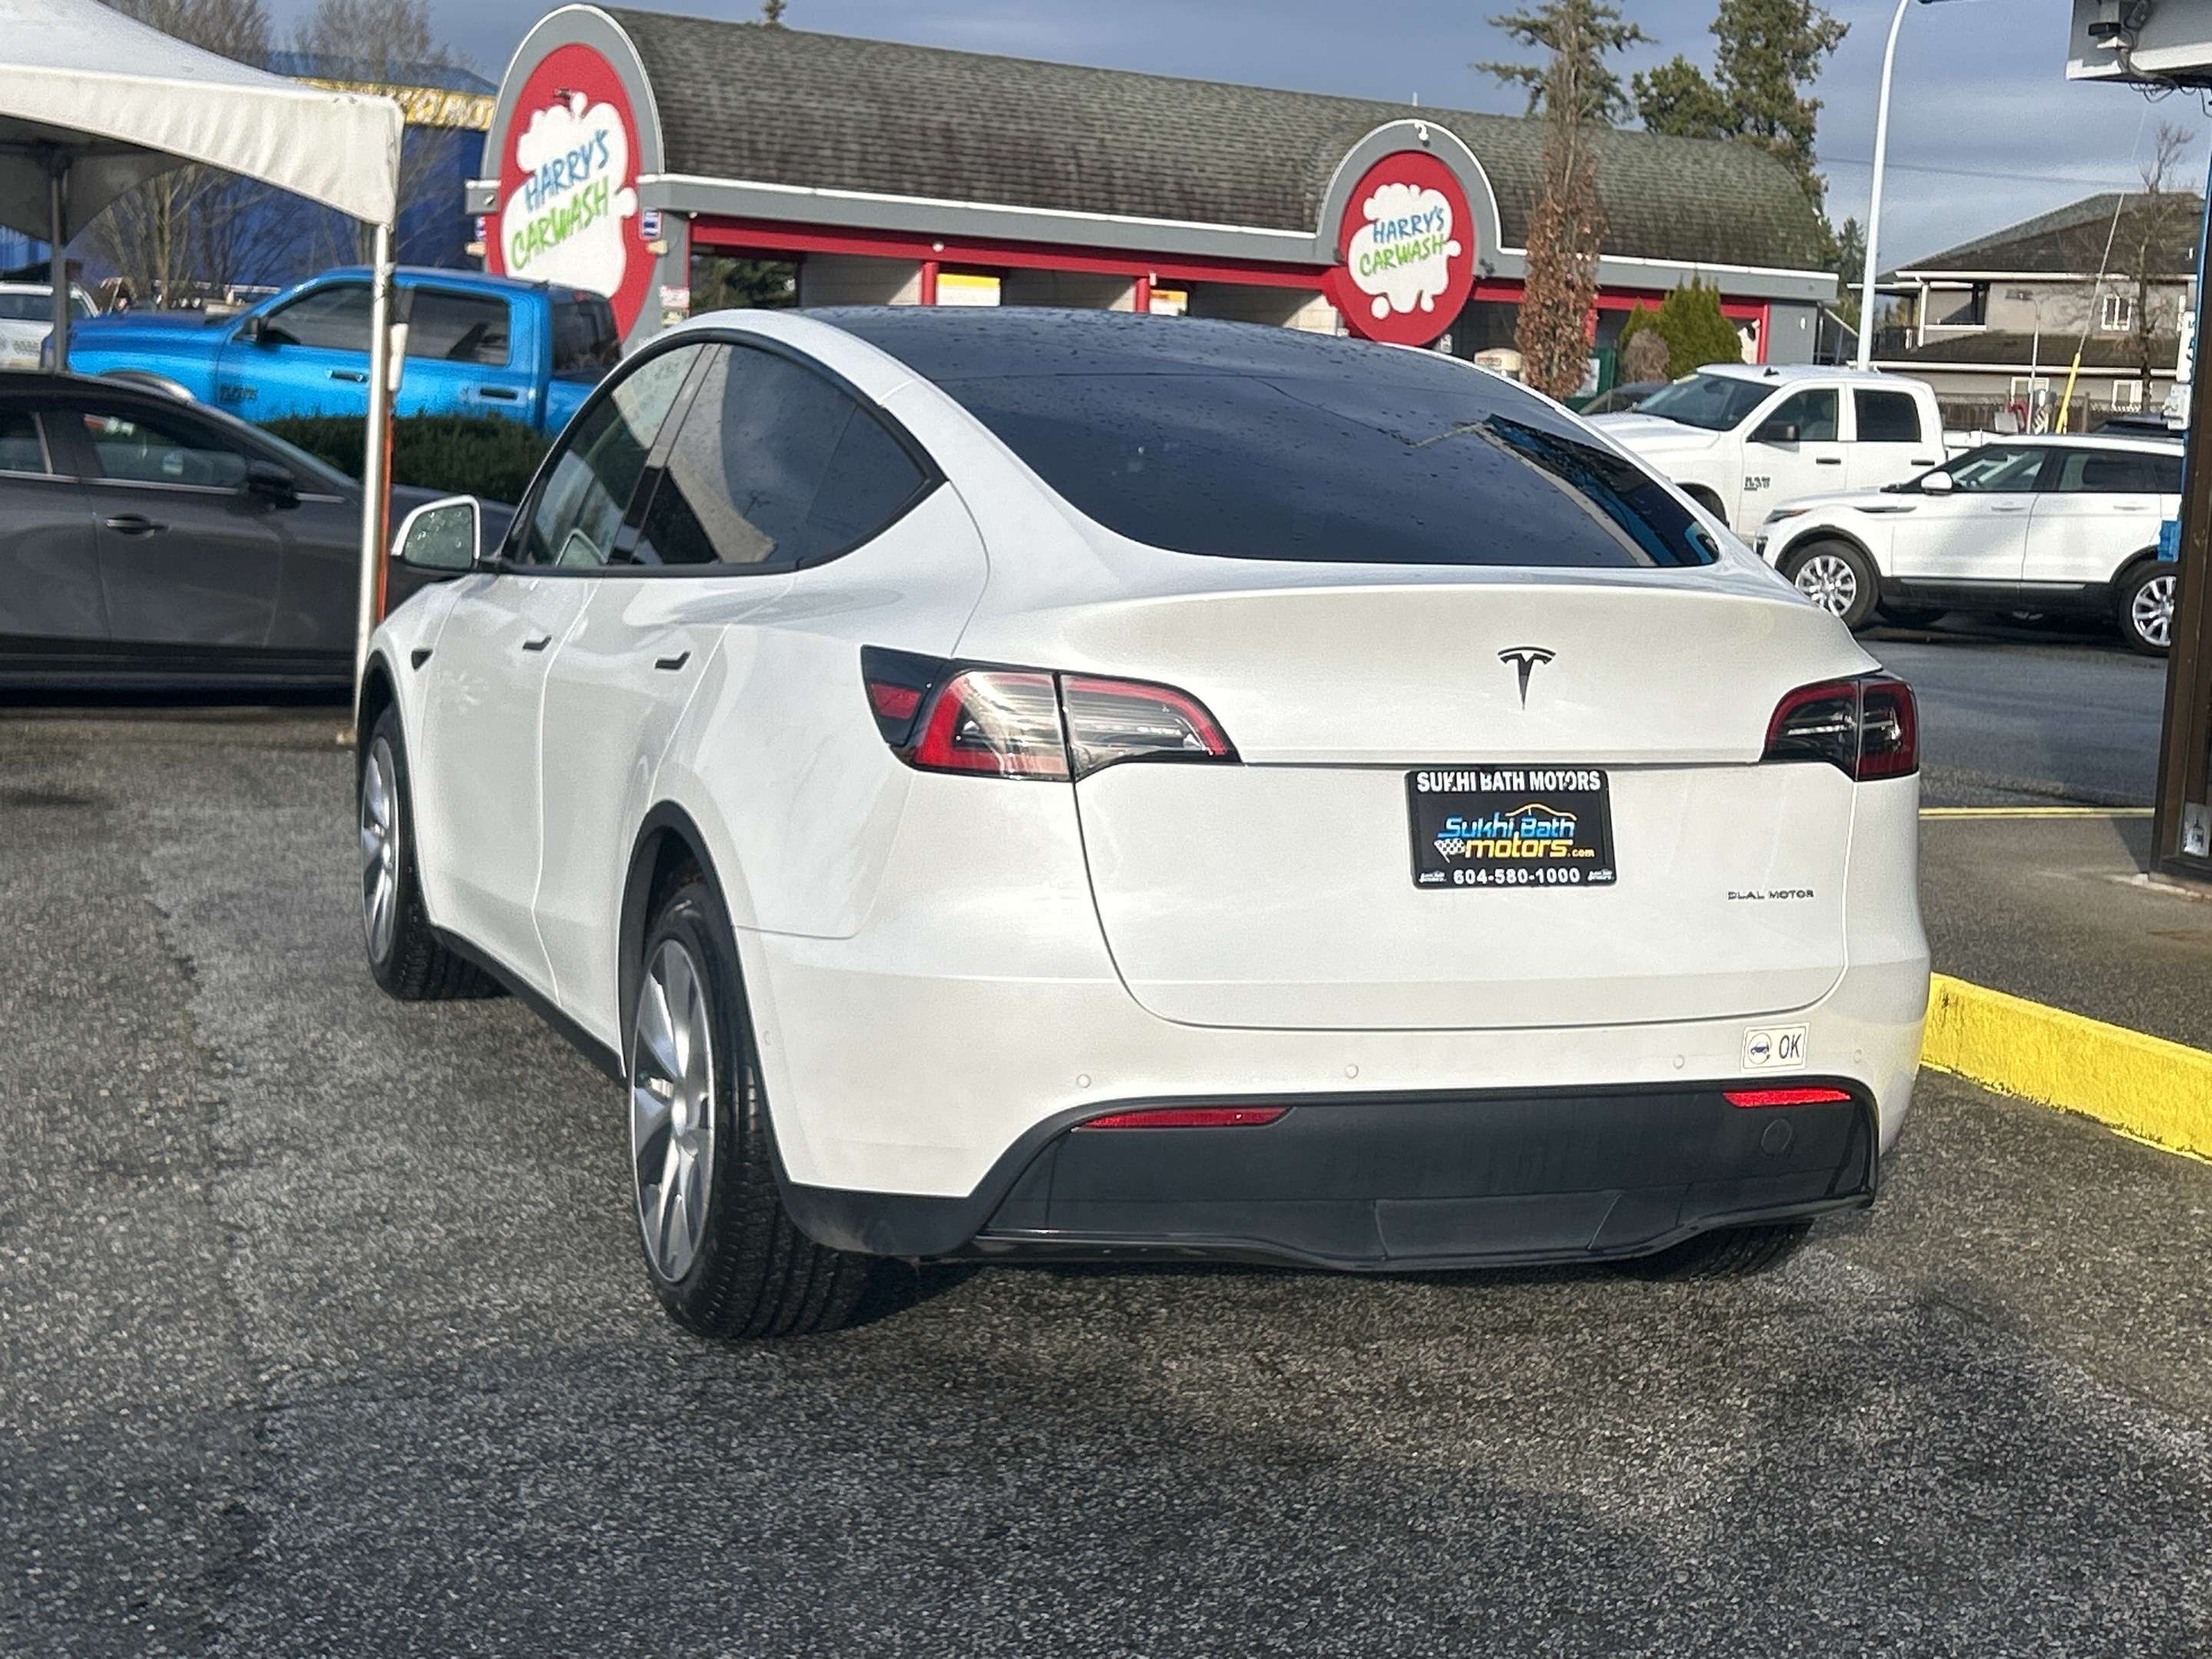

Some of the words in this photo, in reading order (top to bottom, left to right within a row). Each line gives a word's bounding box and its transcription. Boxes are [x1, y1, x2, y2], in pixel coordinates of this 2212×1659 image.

[525, 128, 609, 213] HARRY'S
[512, 174, 609, 270] CARWASH
[1373, 206, 1445, 243] HARRY'S
[1359, 233, 1446, 276] CARWASH
[1417, 771, 1476, 793] SUKHI
[1480, 771, 1525, 791] BATH
[1529, 770, 1601, 791] MOTORS
[1438, 812, 1514, 839] Sukhi
[1520, 816, 1575, 838] Bath
[1453, 867, 1581, 884] 604-580-1000
[1769, 889, 1814, 899] MOTOR
[1779, 1033, 1802, 1059] OK
